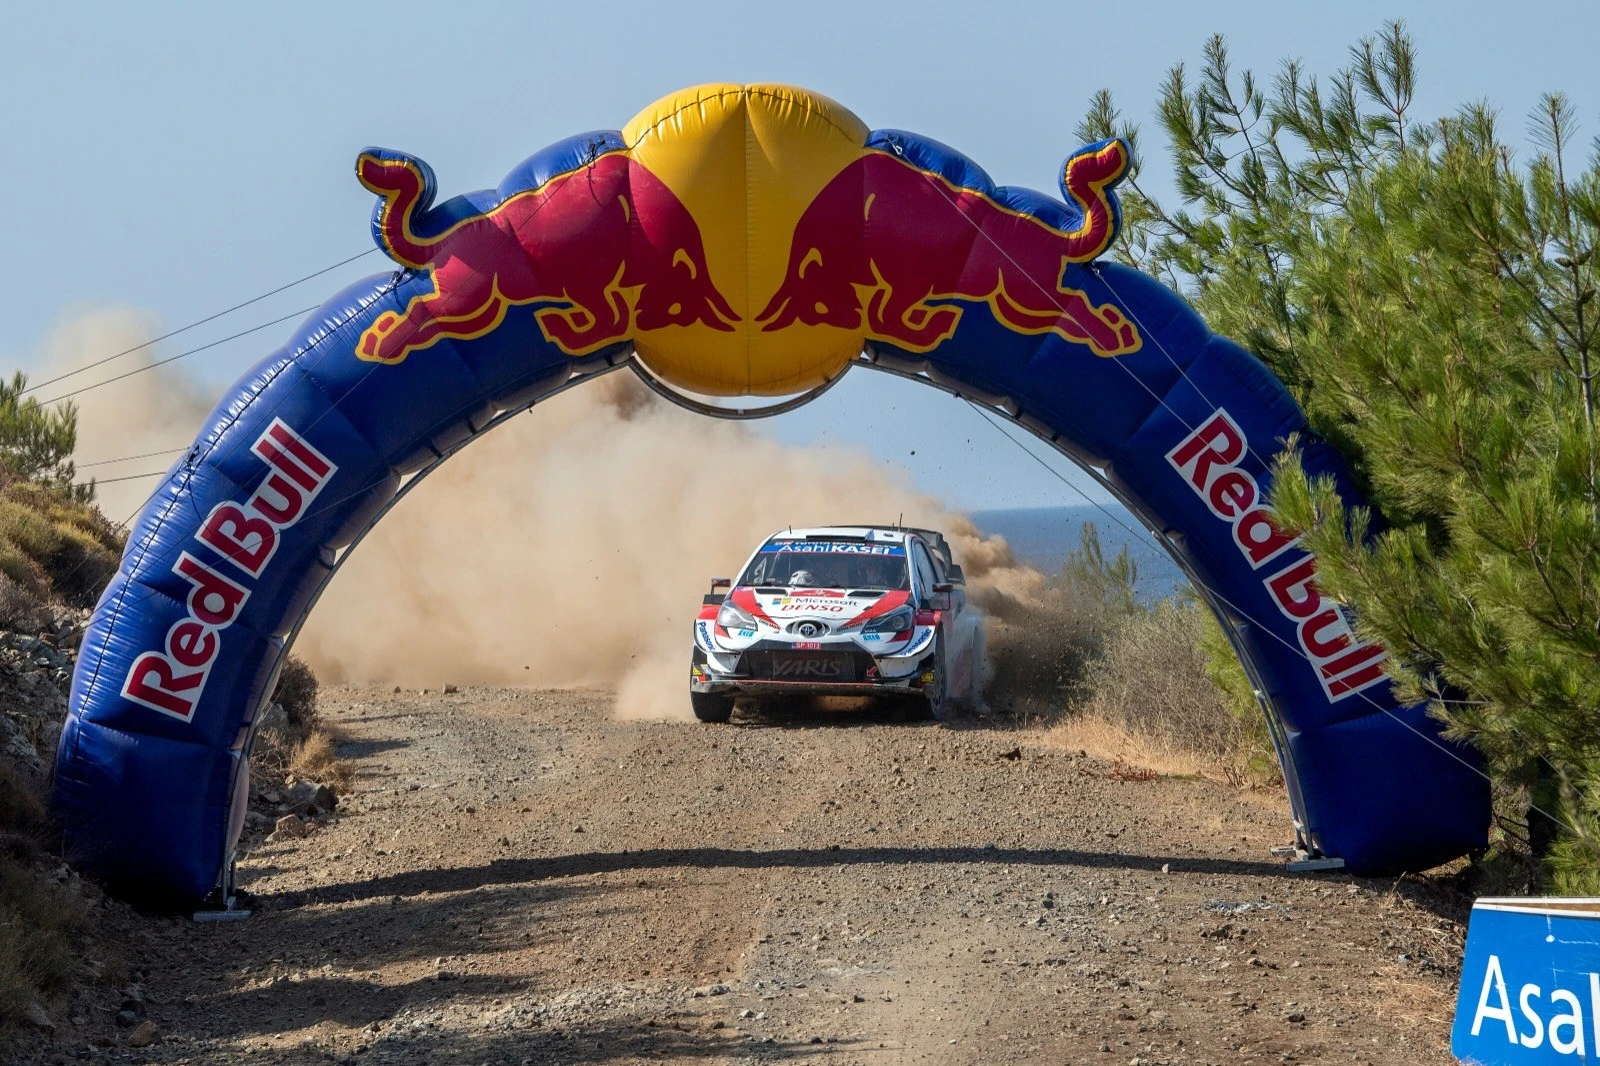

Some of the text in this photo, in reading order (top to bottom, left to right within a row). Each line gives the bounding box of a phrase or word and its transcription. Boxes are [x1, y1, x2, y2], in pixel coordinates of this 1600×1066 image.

[1165, 406, 1308, 570] Red
[779, 544, 890, 555] Asahi KASEI
[120, 416, 338, 723] Red Bull
[795, 597, 858, 607] Microsoft
[781, 604, 844, 612] DENSO
